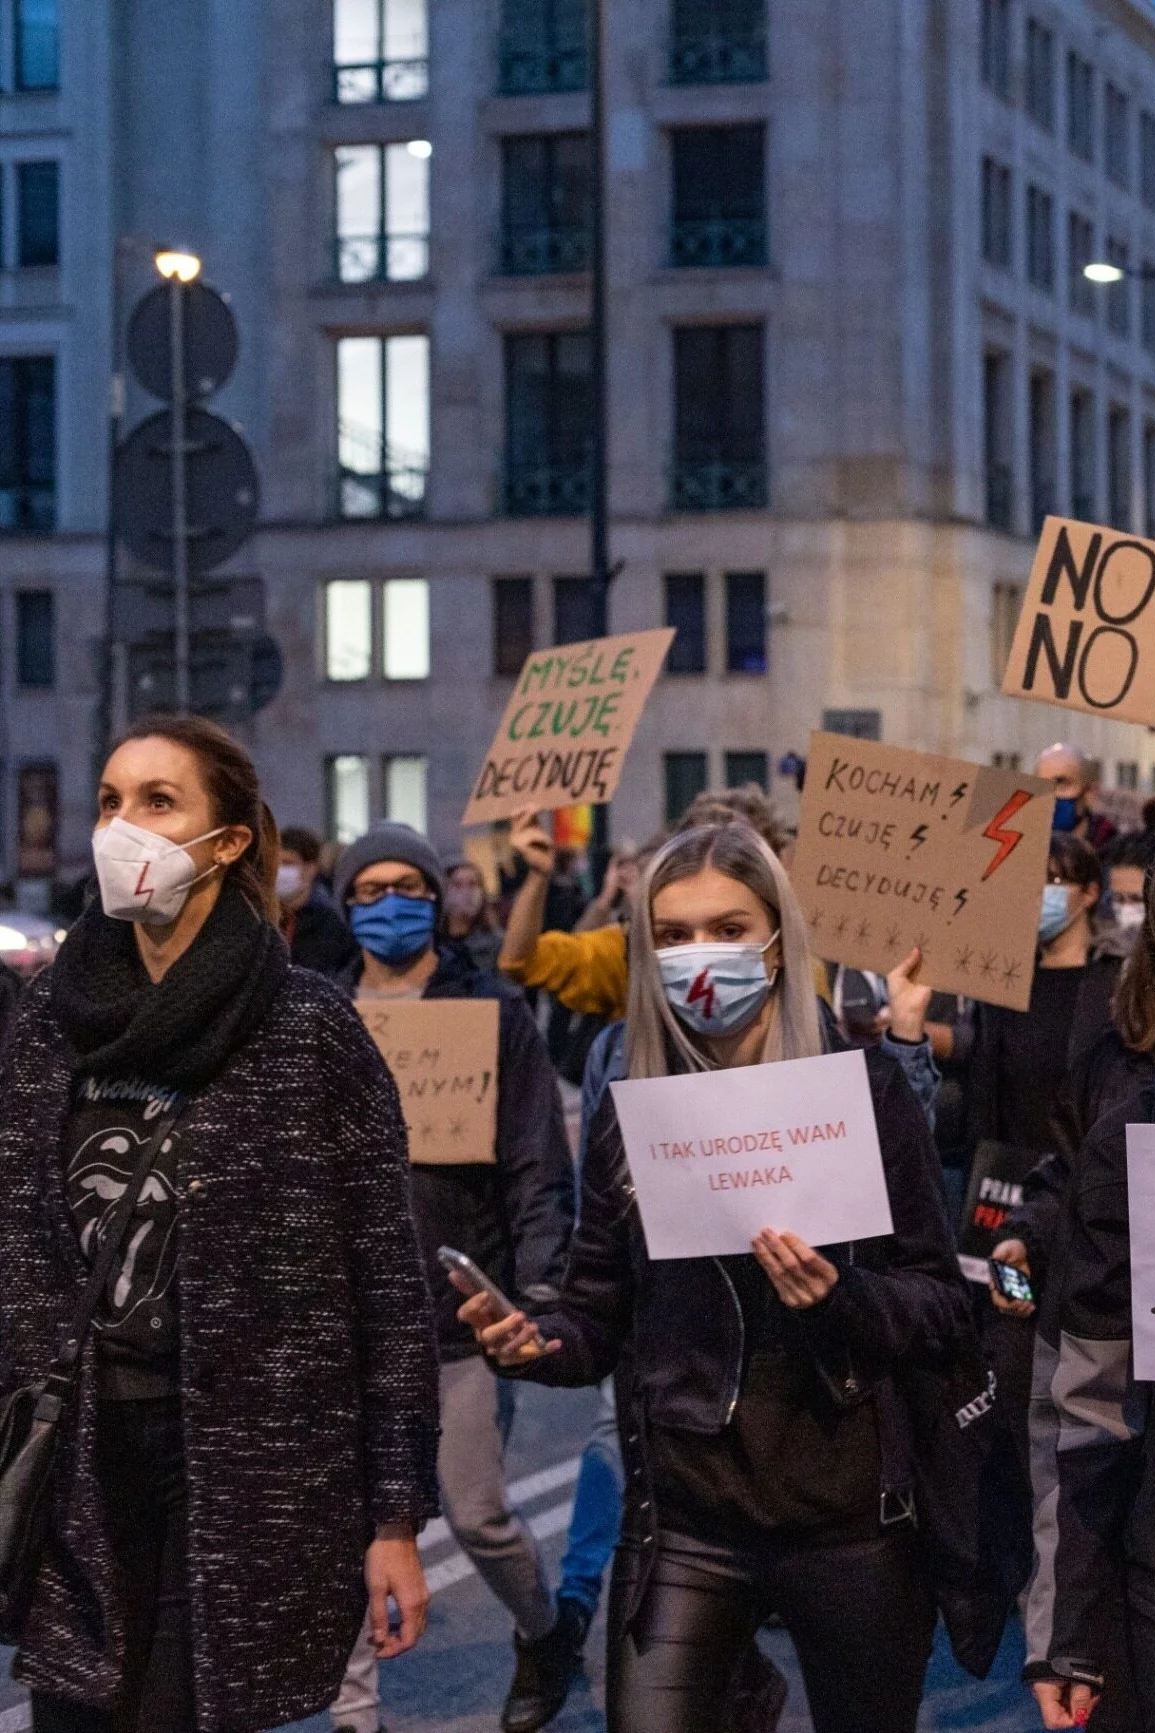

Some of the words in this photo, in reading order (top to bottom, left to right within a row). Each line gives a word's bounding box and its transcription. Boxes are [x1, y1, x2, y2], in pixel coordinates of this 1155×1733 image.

[1021, 612, 1139, 709] NO
[475, 746, 618, 800] DECYDUJĘ
[650, 1144, 657, 1160] I
[659, 1140, 696, 1160] TAK
[699, 1130, 784, 1157] URODZĘ
[786, 1120, 848, 1146] WAM
[707, 1165, 794, 1191] LEWAKA
